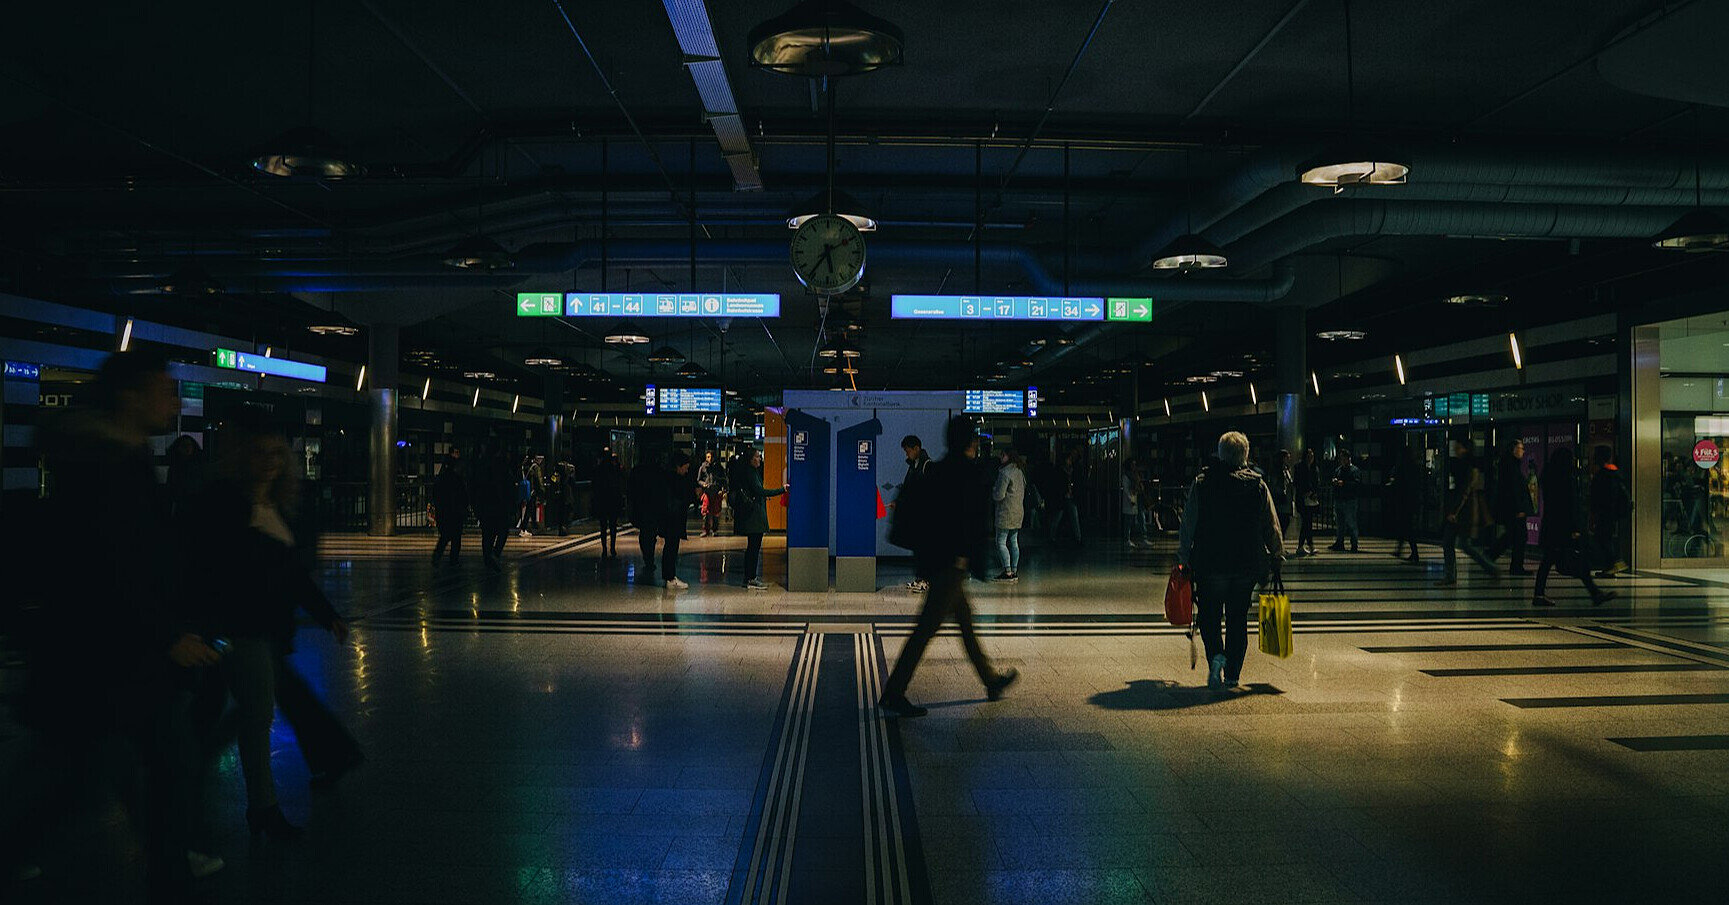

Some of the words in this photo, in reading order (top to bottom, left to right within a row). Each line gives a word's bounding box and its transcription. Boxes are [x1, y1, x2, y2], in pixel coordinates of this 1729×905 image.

[593, 302, 605, 312] 41
[625, 302, 641, 312] 44
[966, 304, 974, 315] 3
[998, 305, 1011, 316] 17
[1031, 306, 1044, 316] 21
[1064, 307, 1079, 317] 34
